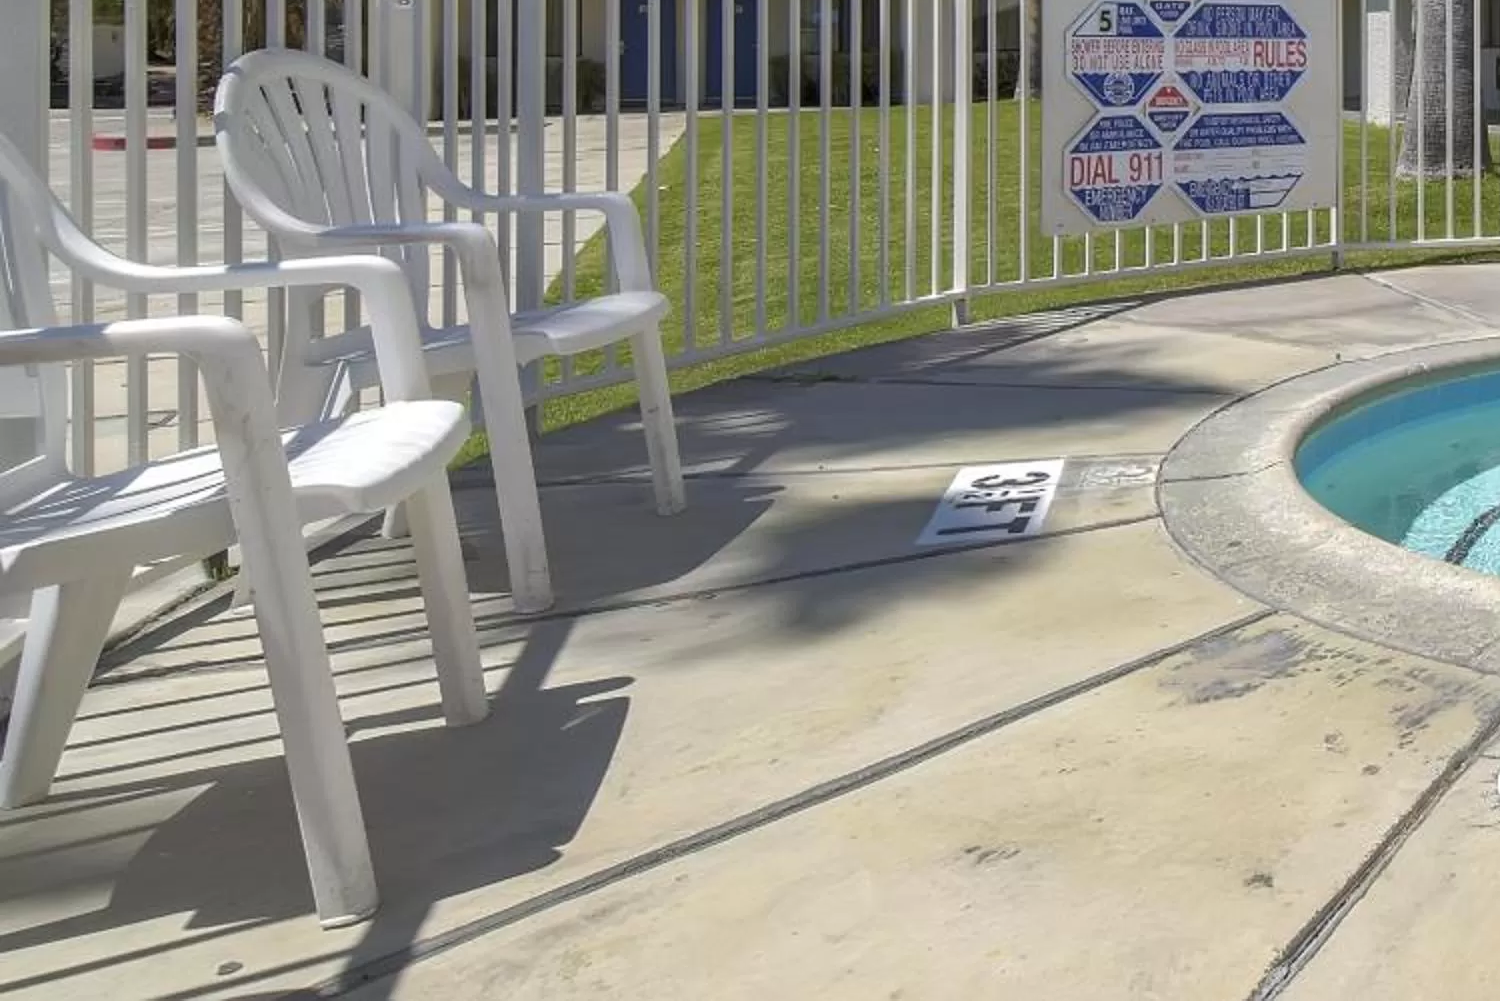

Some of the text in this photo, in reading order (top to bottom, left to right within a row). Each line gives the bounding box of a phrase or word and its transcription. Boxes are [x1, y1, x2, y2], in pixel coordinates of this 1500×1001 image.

[1099, 10, 1112, 32] 5
[1253, 40, 1307, 68] RULES
[1071, 151, 1163, 186] DIAL 911
[936, 496, 1041, 535] FT
